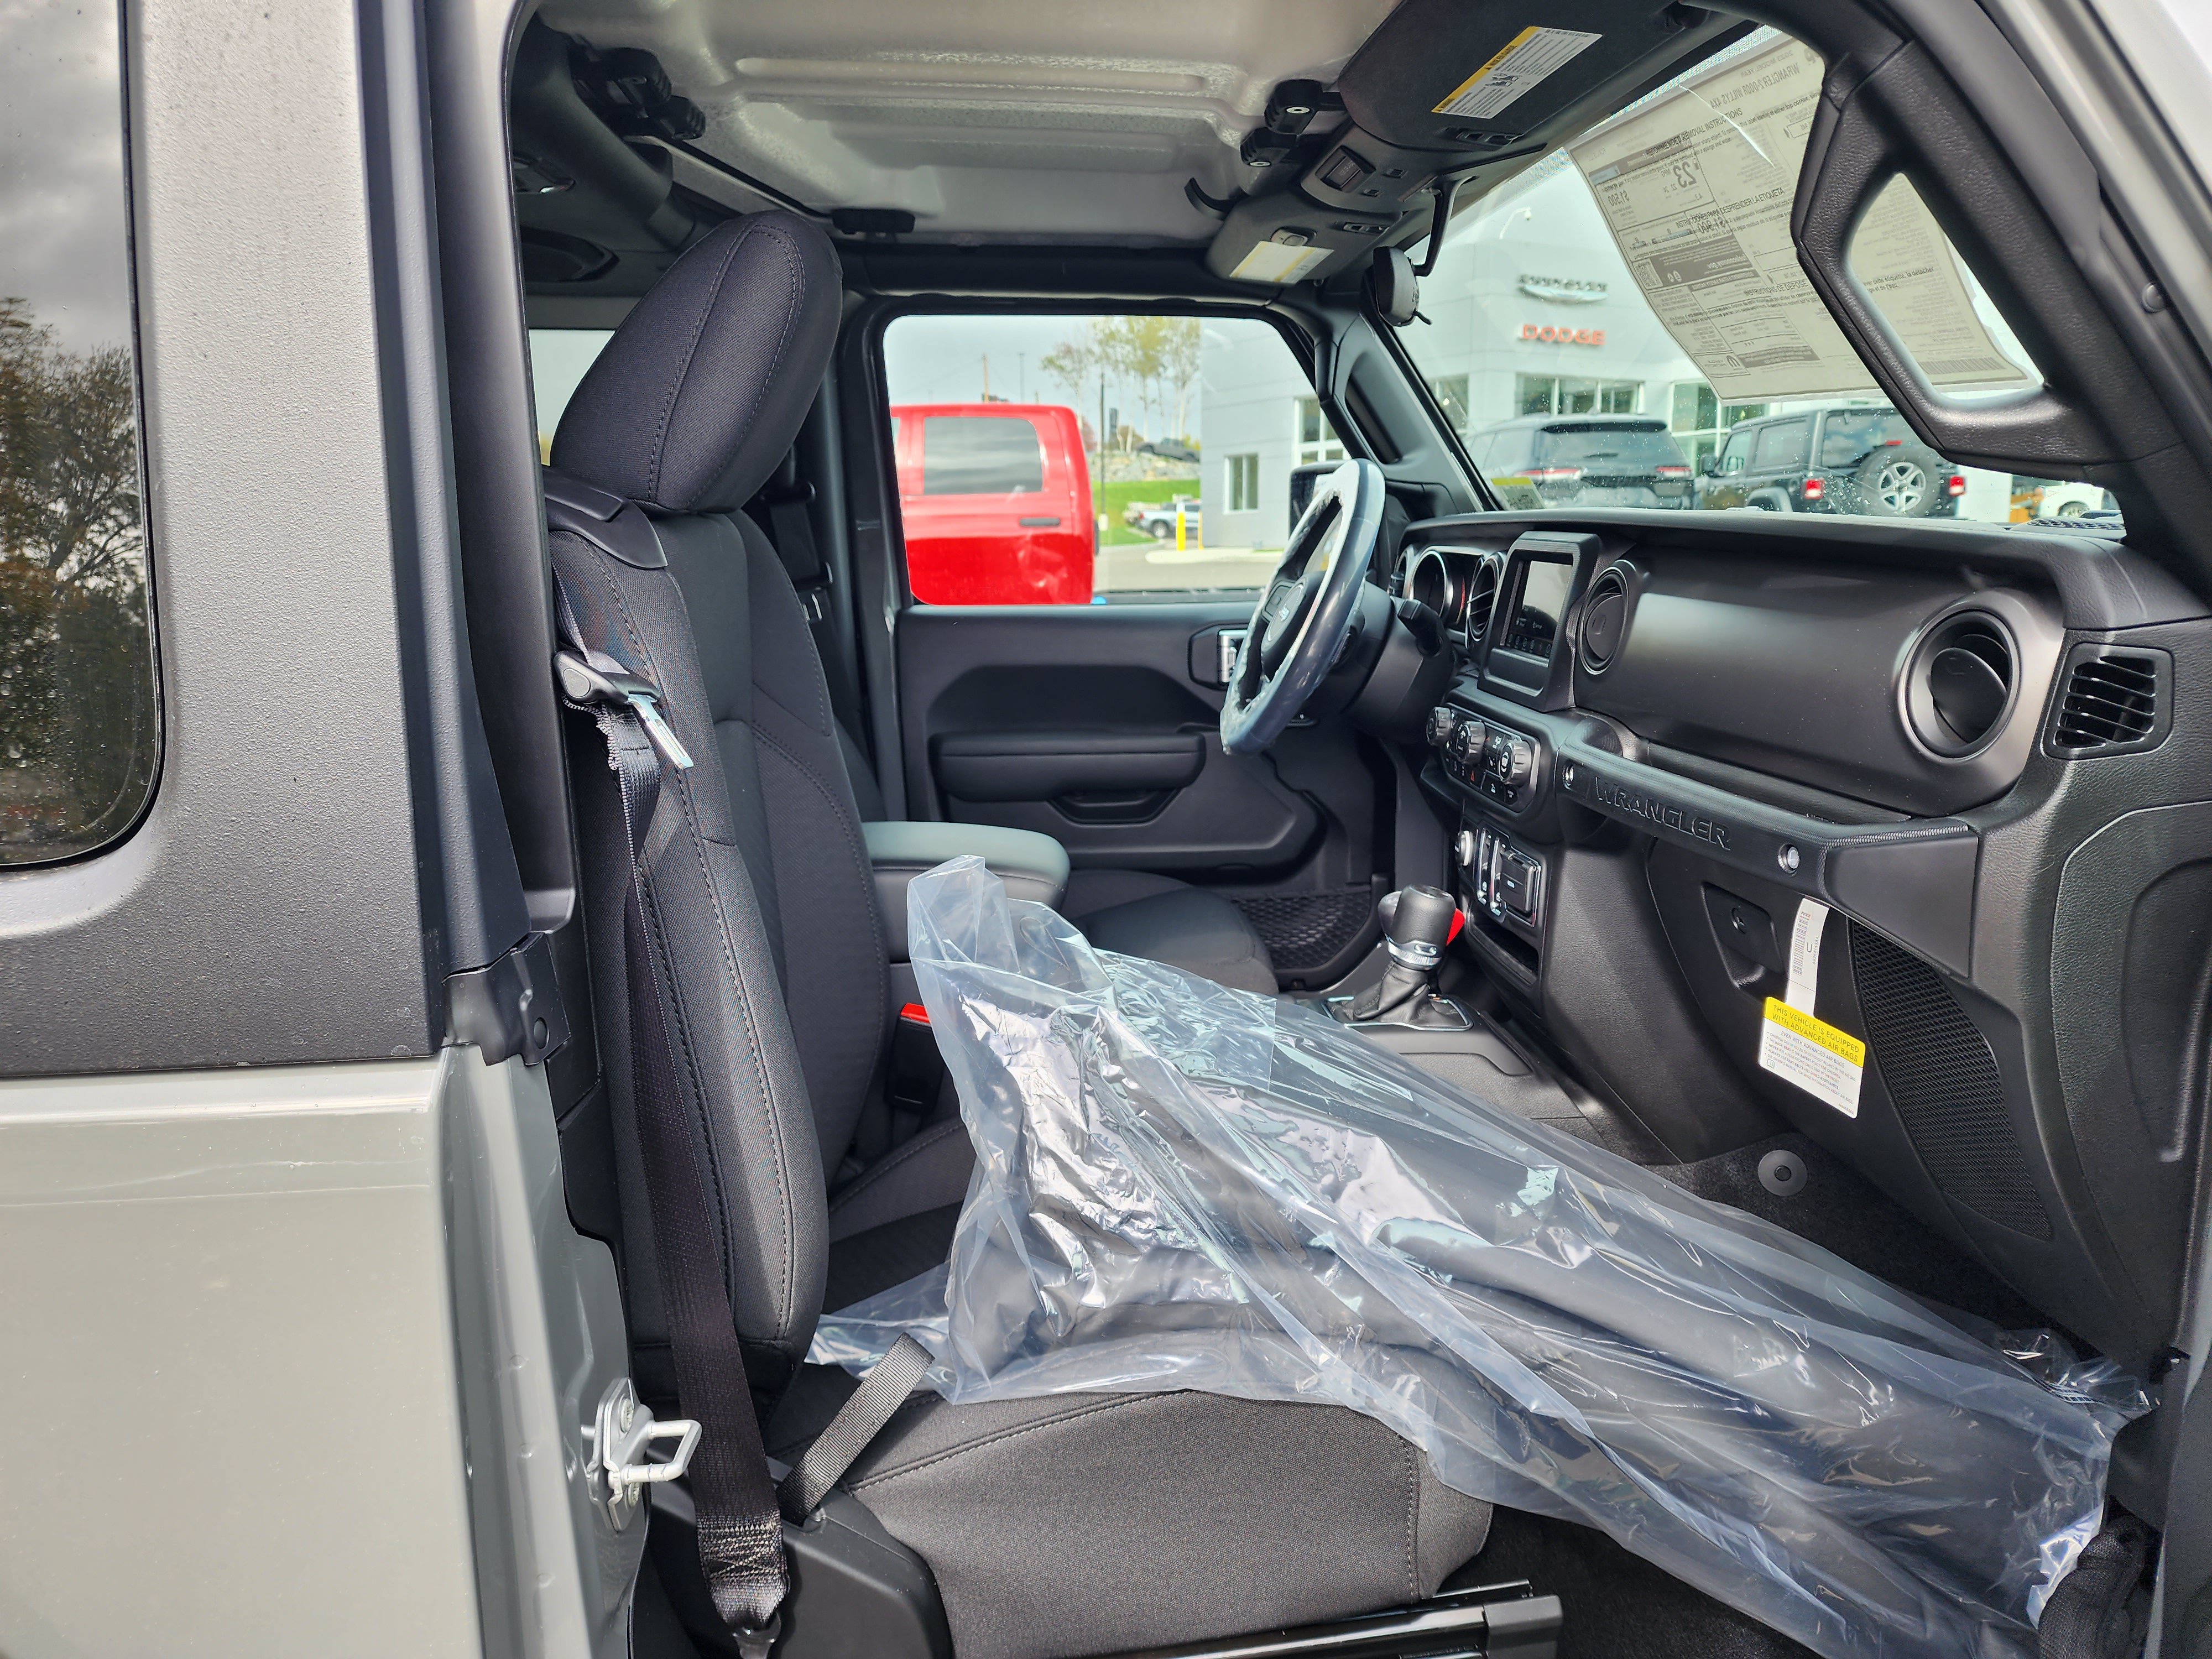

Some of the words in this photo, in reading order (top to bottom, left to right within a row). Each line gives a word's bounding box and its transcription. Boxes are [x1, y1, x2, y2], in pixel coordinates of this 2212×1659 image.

[1682, 126, 1705, 140] REMOVAL
[1704, 107, 1743, 131] INSTRUCTIONS
[1720, 197, 1753, 215] DESPRENDER
[1751, 195, 1760, 204] LA
[1759, 186, 1786, 201] ETIQUETA
[1912, 267, 1934, 276] détacher
[1523, 324, 1606, 346] DODGE
[1595, 776, 1731, 852] WRANGLER
[1772, 1013, 1788, 1026] WITH
[1790, 1021, 1826, 1045] ADVANCED
[1828, 1040, 1839, 1051] AIR
[1840, 1047, 1858, 1062] BAGS
[1773, 1004, 1788, 1016] THIS
[1789, 1012, 1817, 1031] VEHICLE
[1826, 1031, 1859, 1053] EQUIPPED
[1781, 1030, 1791, 1040] EVEN
[1792, 1036, 1802, 1045] WITH
[1803, 1042, 1825, 1057] ADVANCED
[1834, 1058, 1844, 1068] BAGS
